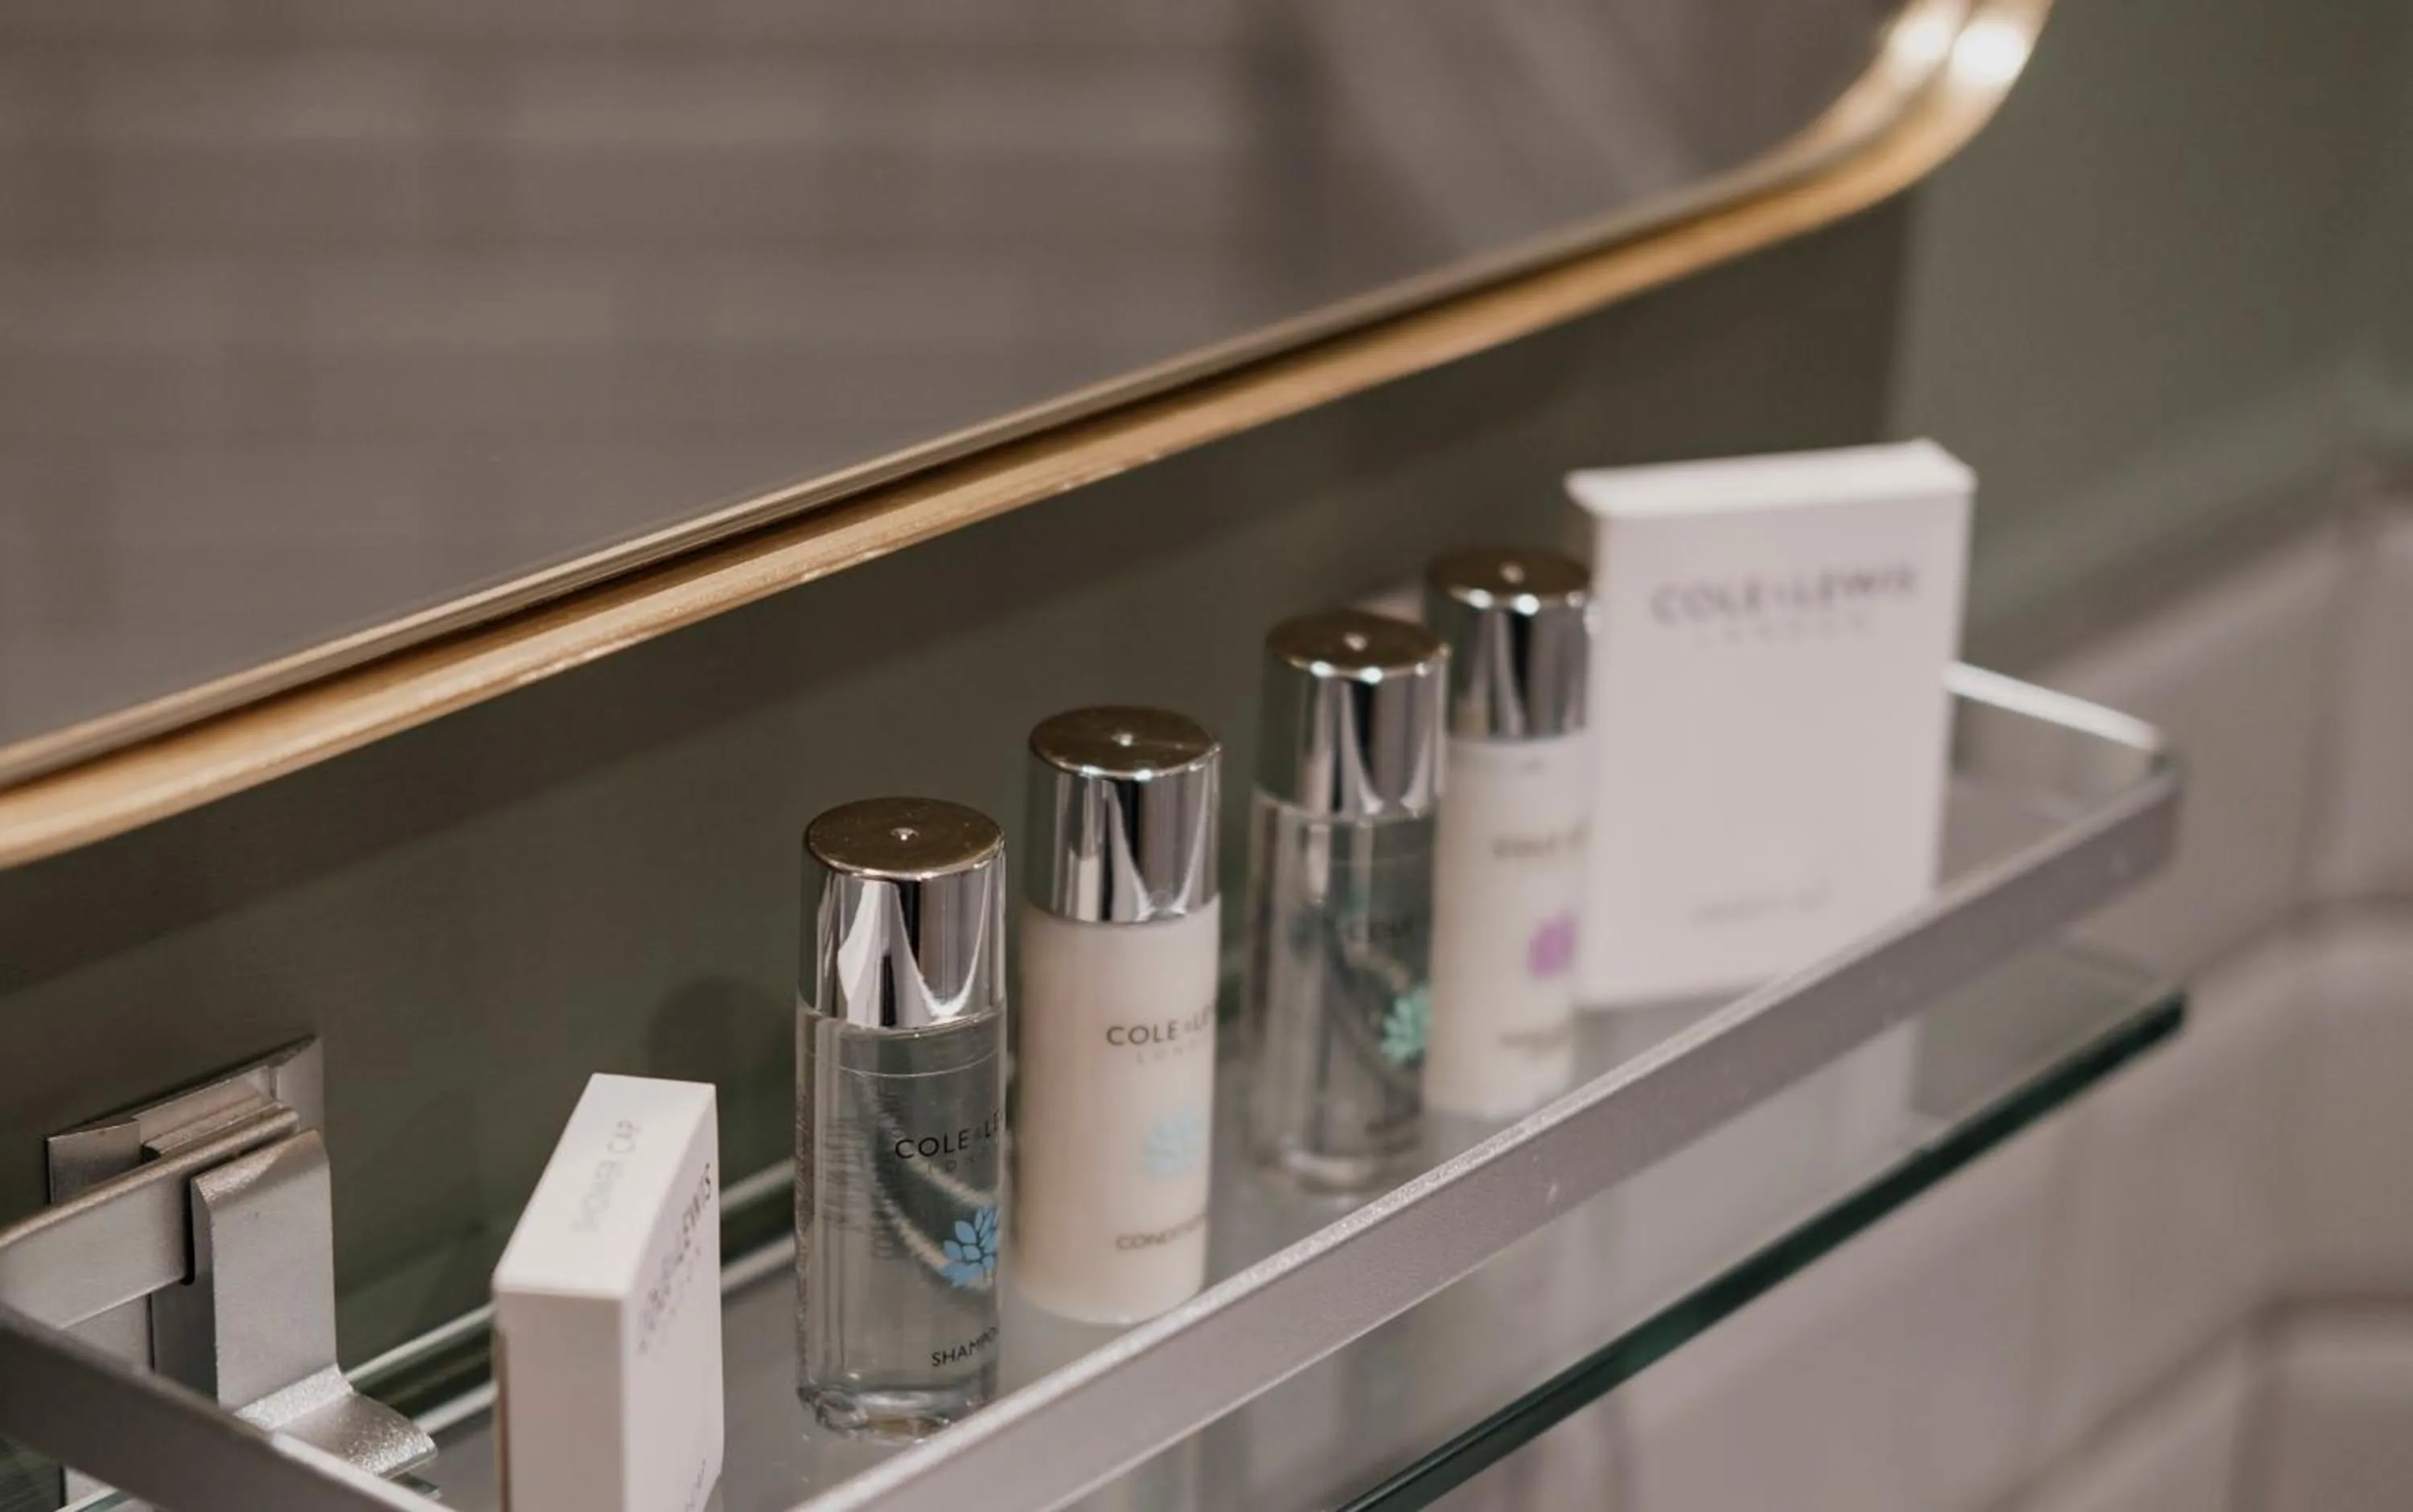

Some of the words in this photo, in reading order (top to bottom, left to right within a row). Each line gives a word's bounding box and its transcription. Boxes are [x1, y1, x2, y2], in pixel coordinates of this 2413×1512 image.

[1106, 1017, 1179, 1047] COLE
[894, 1127, 971, 1160] COLE
[930, 1325, 1000, 1368] SHAMPO
